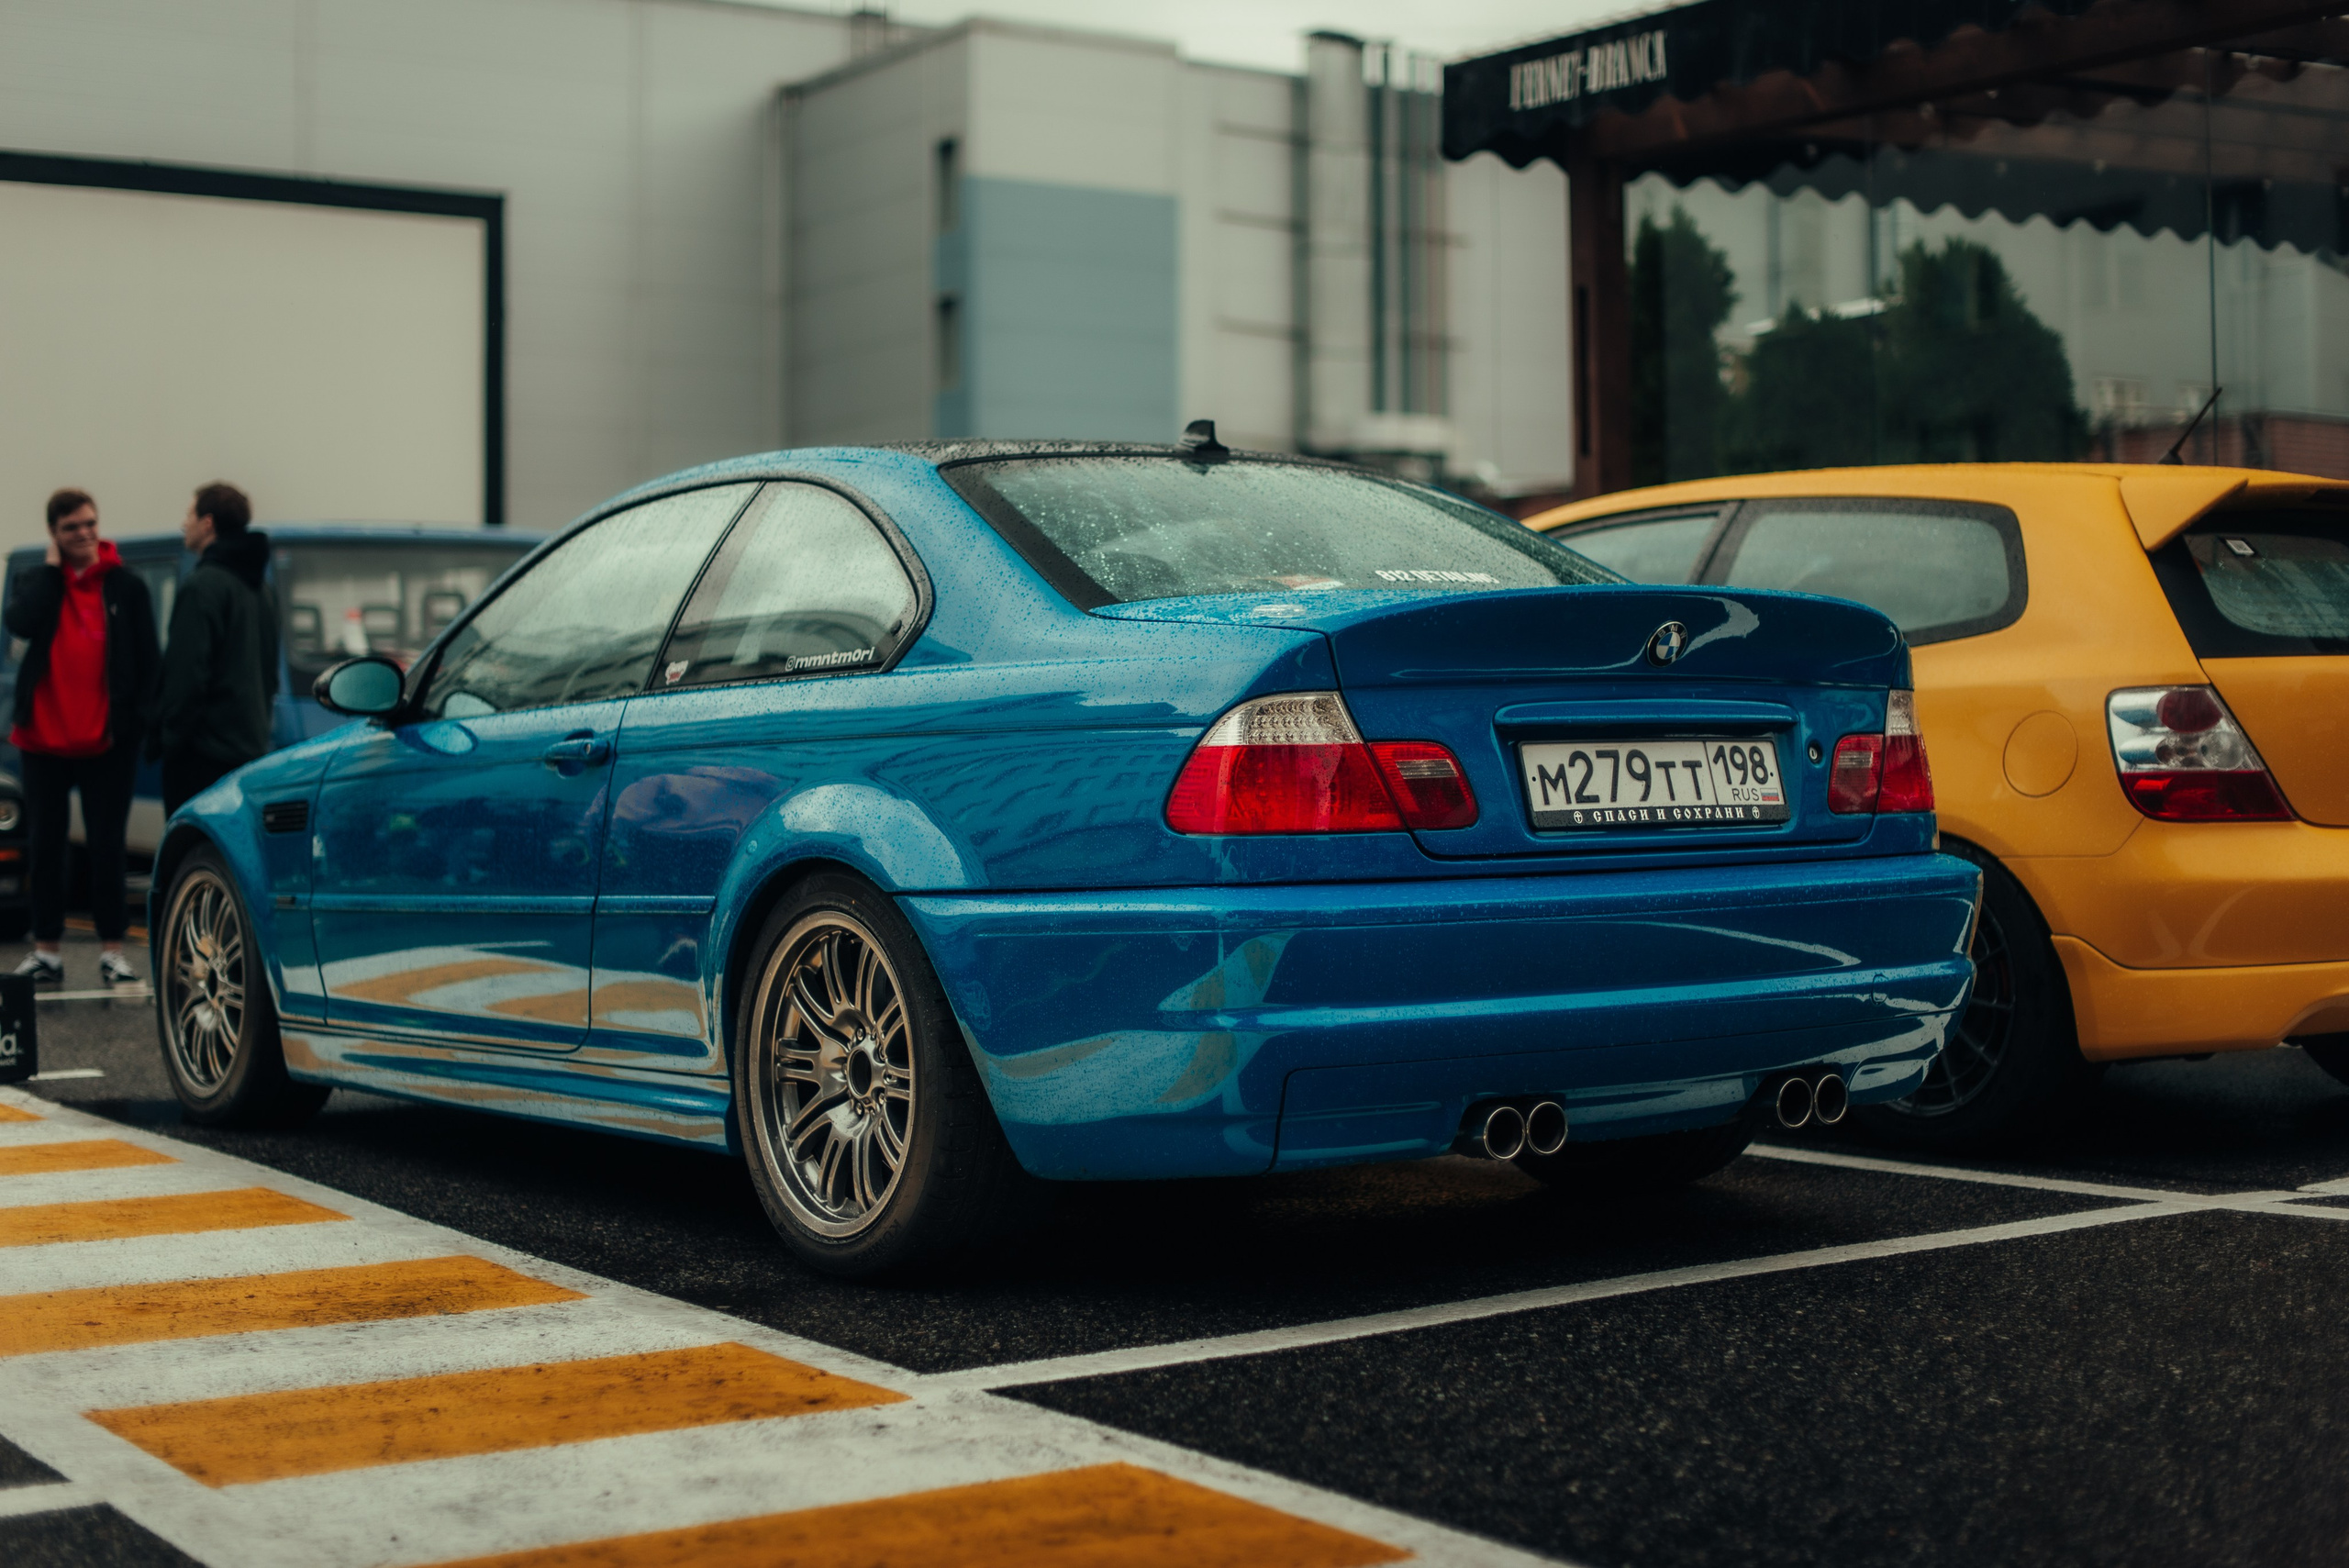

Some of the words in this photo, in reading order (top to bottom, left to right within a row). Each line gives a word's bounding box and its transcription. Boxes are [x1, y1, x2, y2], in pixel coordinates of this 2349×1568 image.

[1375, 570, 1416, 582] 812
[1712, 745, 1769, 785] 198
[1731, 788, 1760, 802] RUS
[1593, 808, 1650, 823] СПАСИ
[1656, 808, 1666, 820] И
[1673, 806, 1745, 820] СОХРАНИ
